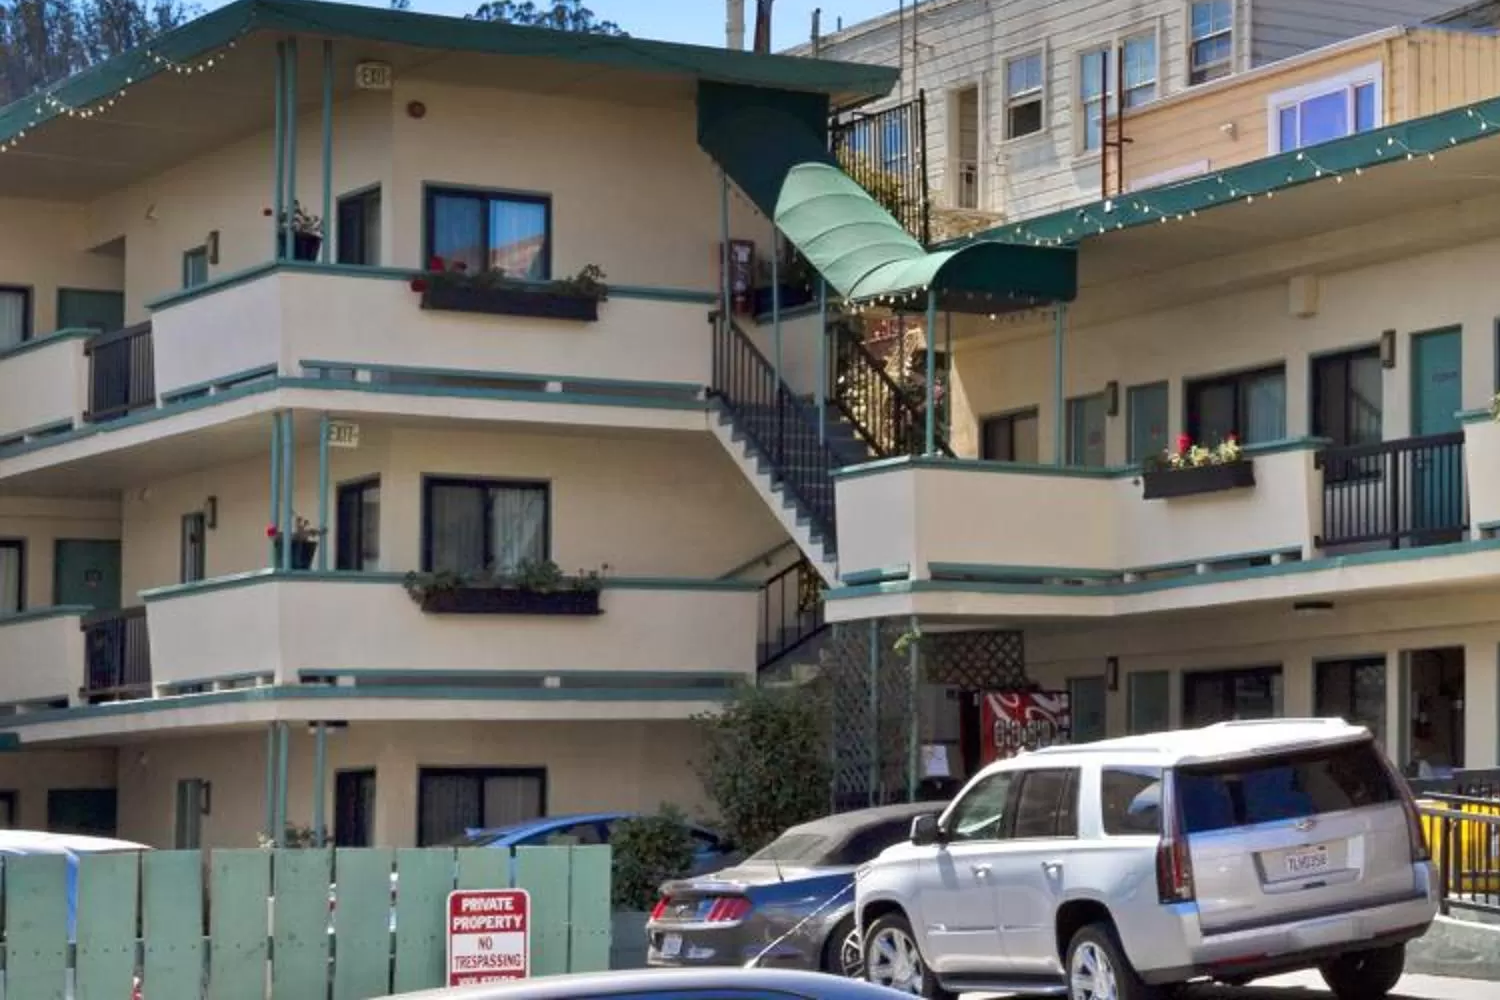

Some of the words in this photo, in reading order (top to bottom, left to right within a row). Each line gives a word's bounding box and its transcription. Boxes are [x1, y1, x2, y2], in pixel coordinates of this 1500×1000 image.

[362, 67, 385, 85] EXIT
[461, 896, 515, 912] PRIVATE
[453, 914, 523, 930] PROPERTY
[478, 936, 493, 950] NO
[455, 953, 521, 969] TRESPASSING
